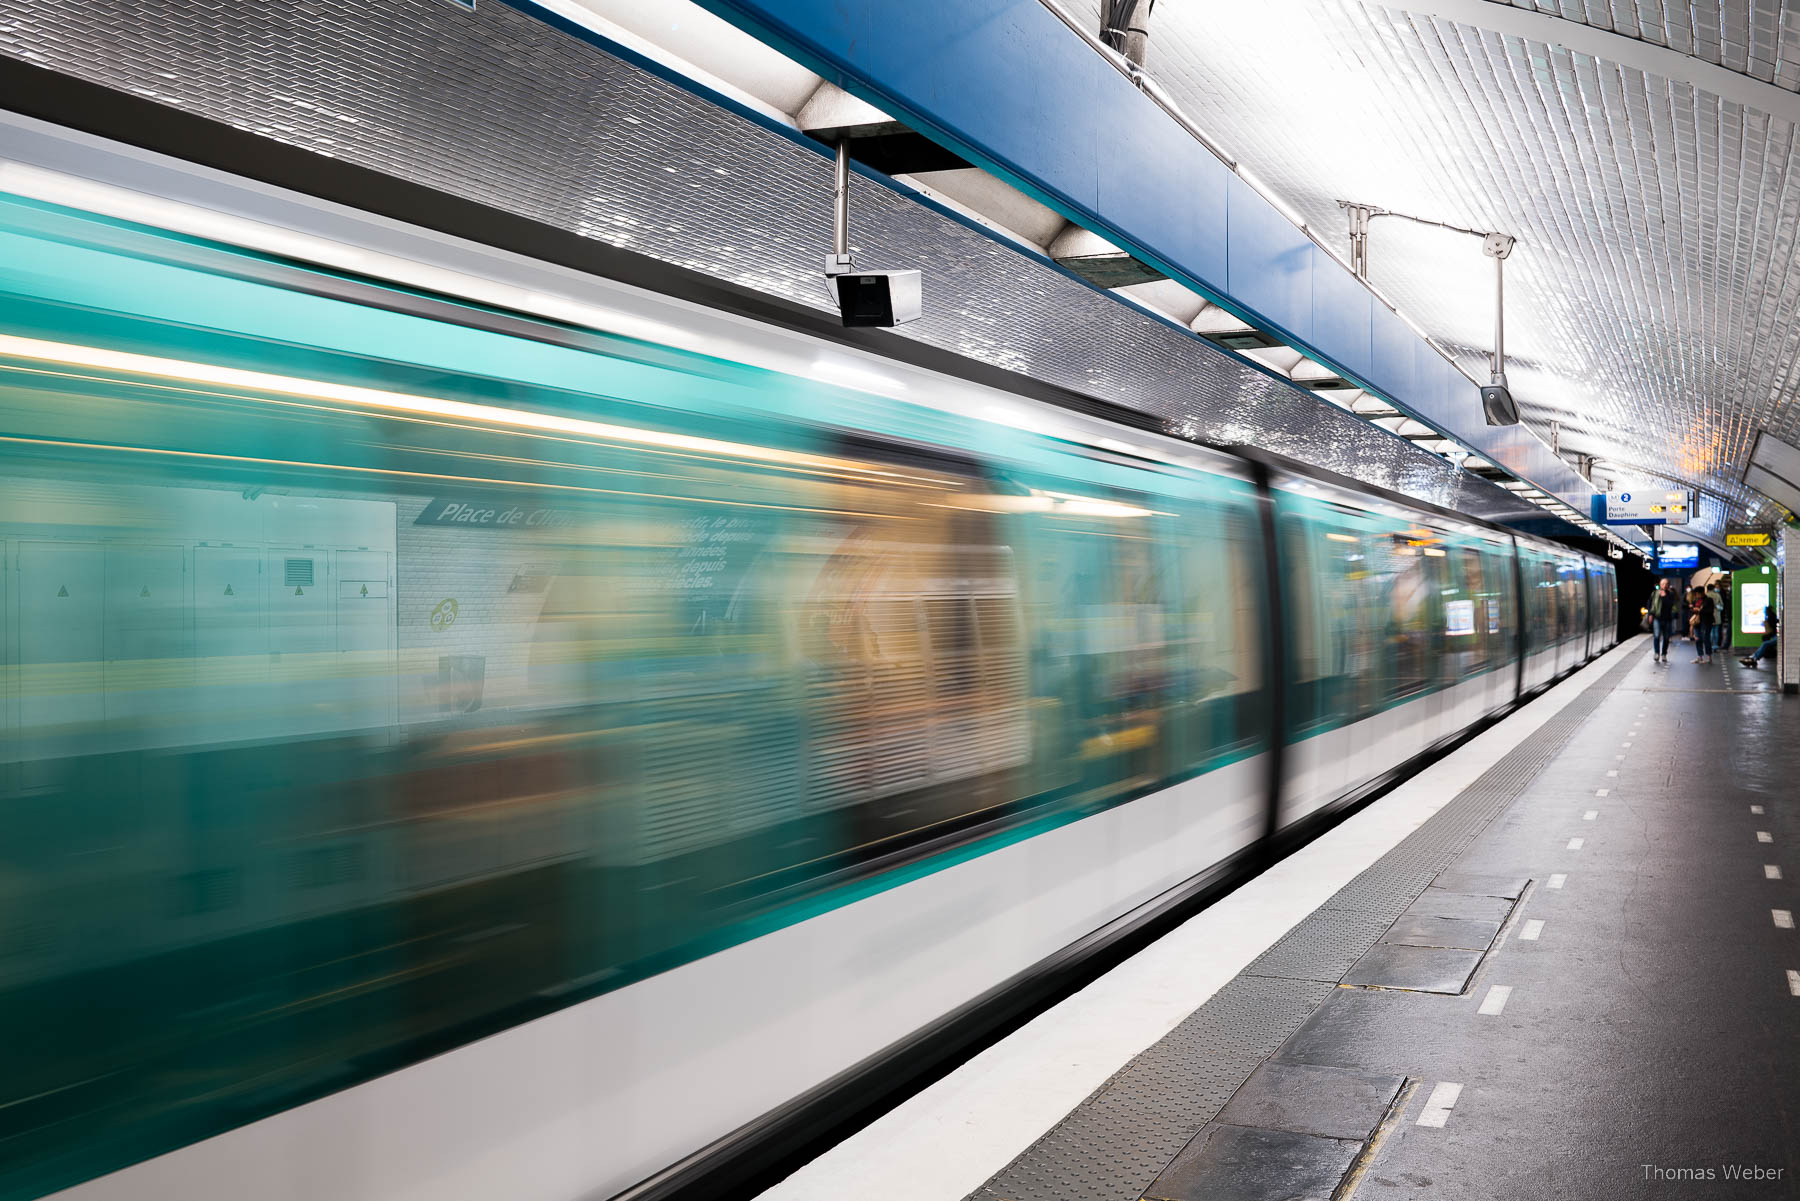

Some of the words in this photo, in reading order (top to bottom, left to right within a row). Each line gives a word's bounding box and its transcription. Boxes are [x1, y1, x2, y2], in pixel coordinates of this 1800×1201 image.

[437, 503, 495, 523] Place
[496, 506, 524, 524] de
[681, 557, 727, 577] depuis
